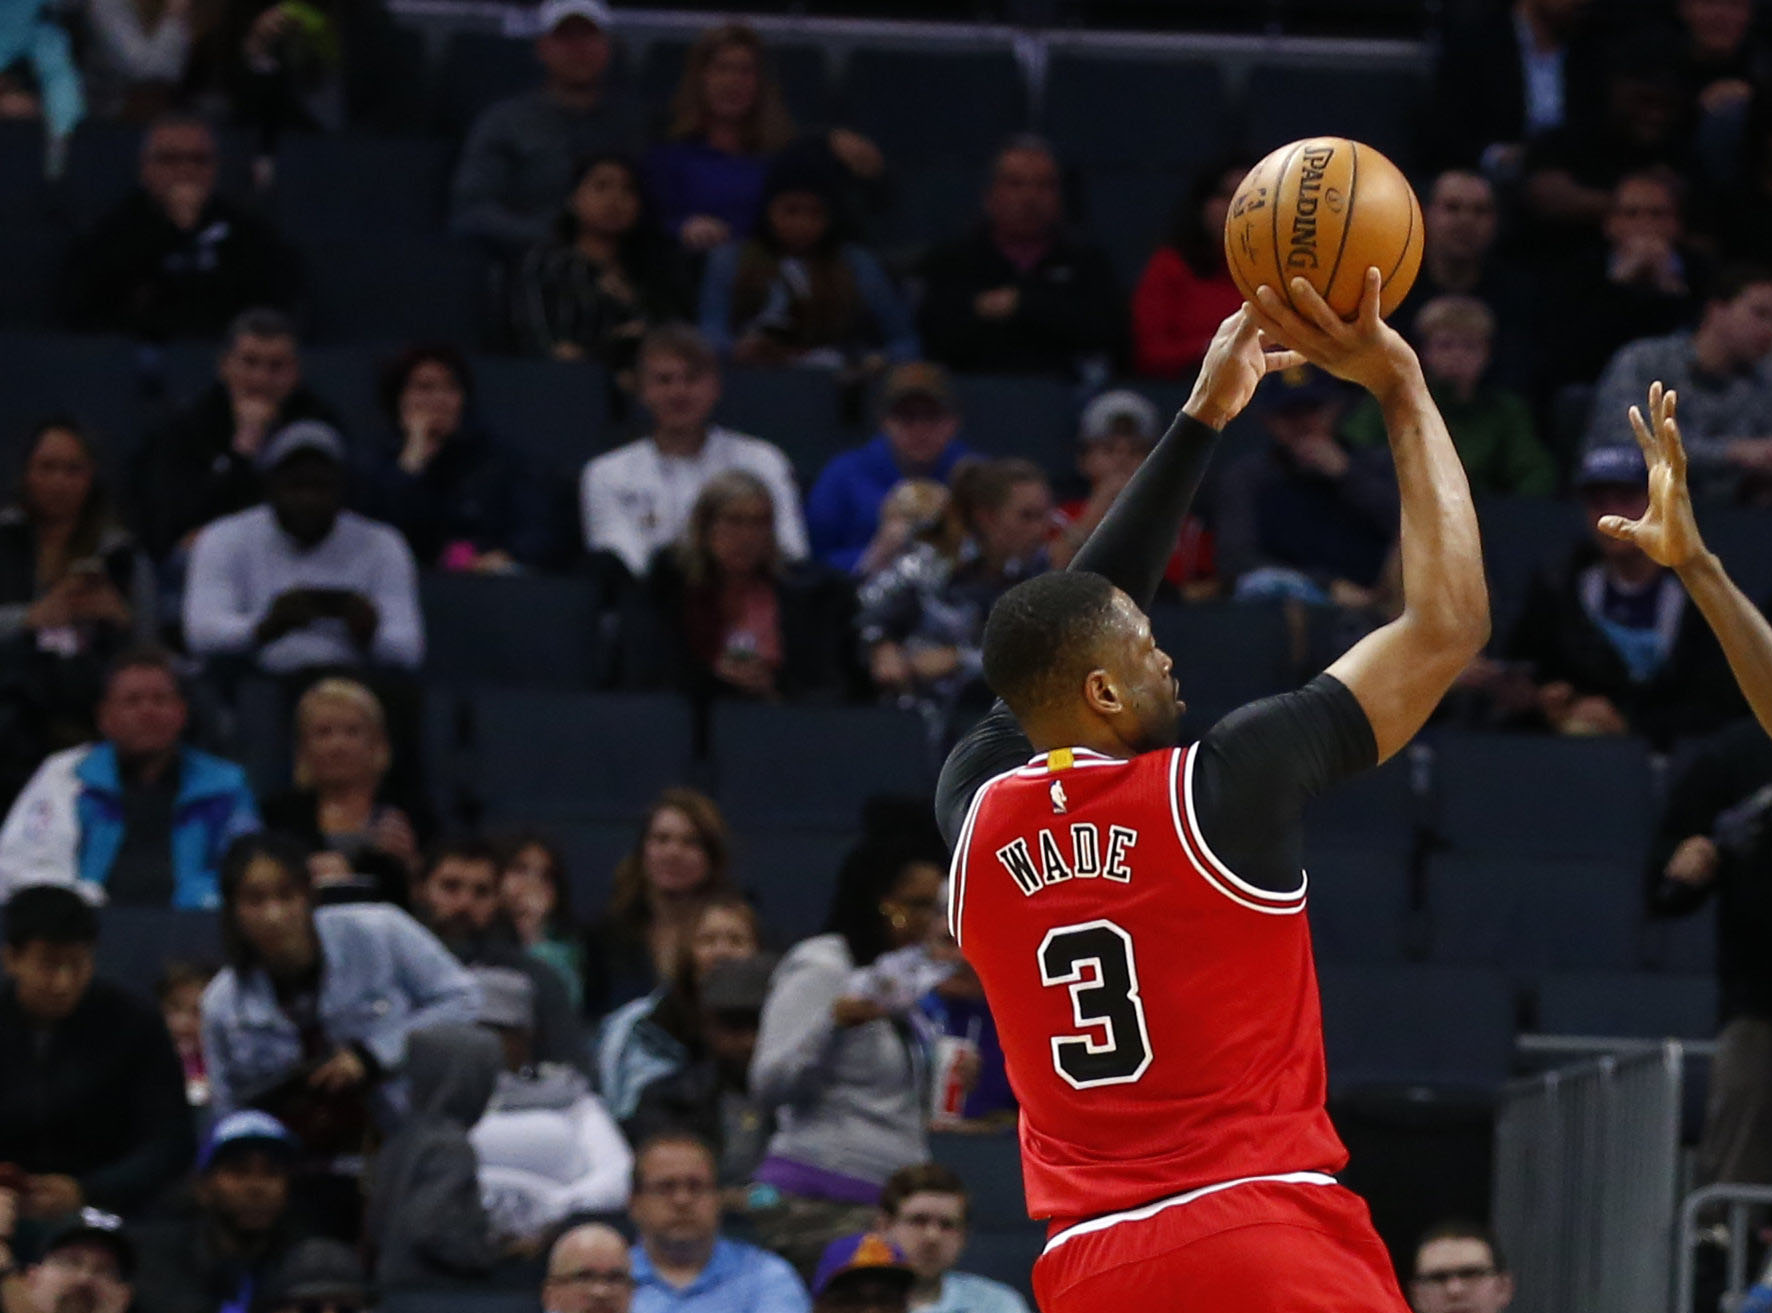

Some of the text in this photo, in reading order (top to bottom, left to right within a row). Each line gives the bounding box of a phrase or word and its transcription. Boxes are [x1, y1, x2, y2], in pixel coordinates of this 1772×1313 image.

[1287, 145, 1335, 270] SPALDING
[995, 823, 1137, 897] WADE
[1037, 918, 1154, 1090] 3
